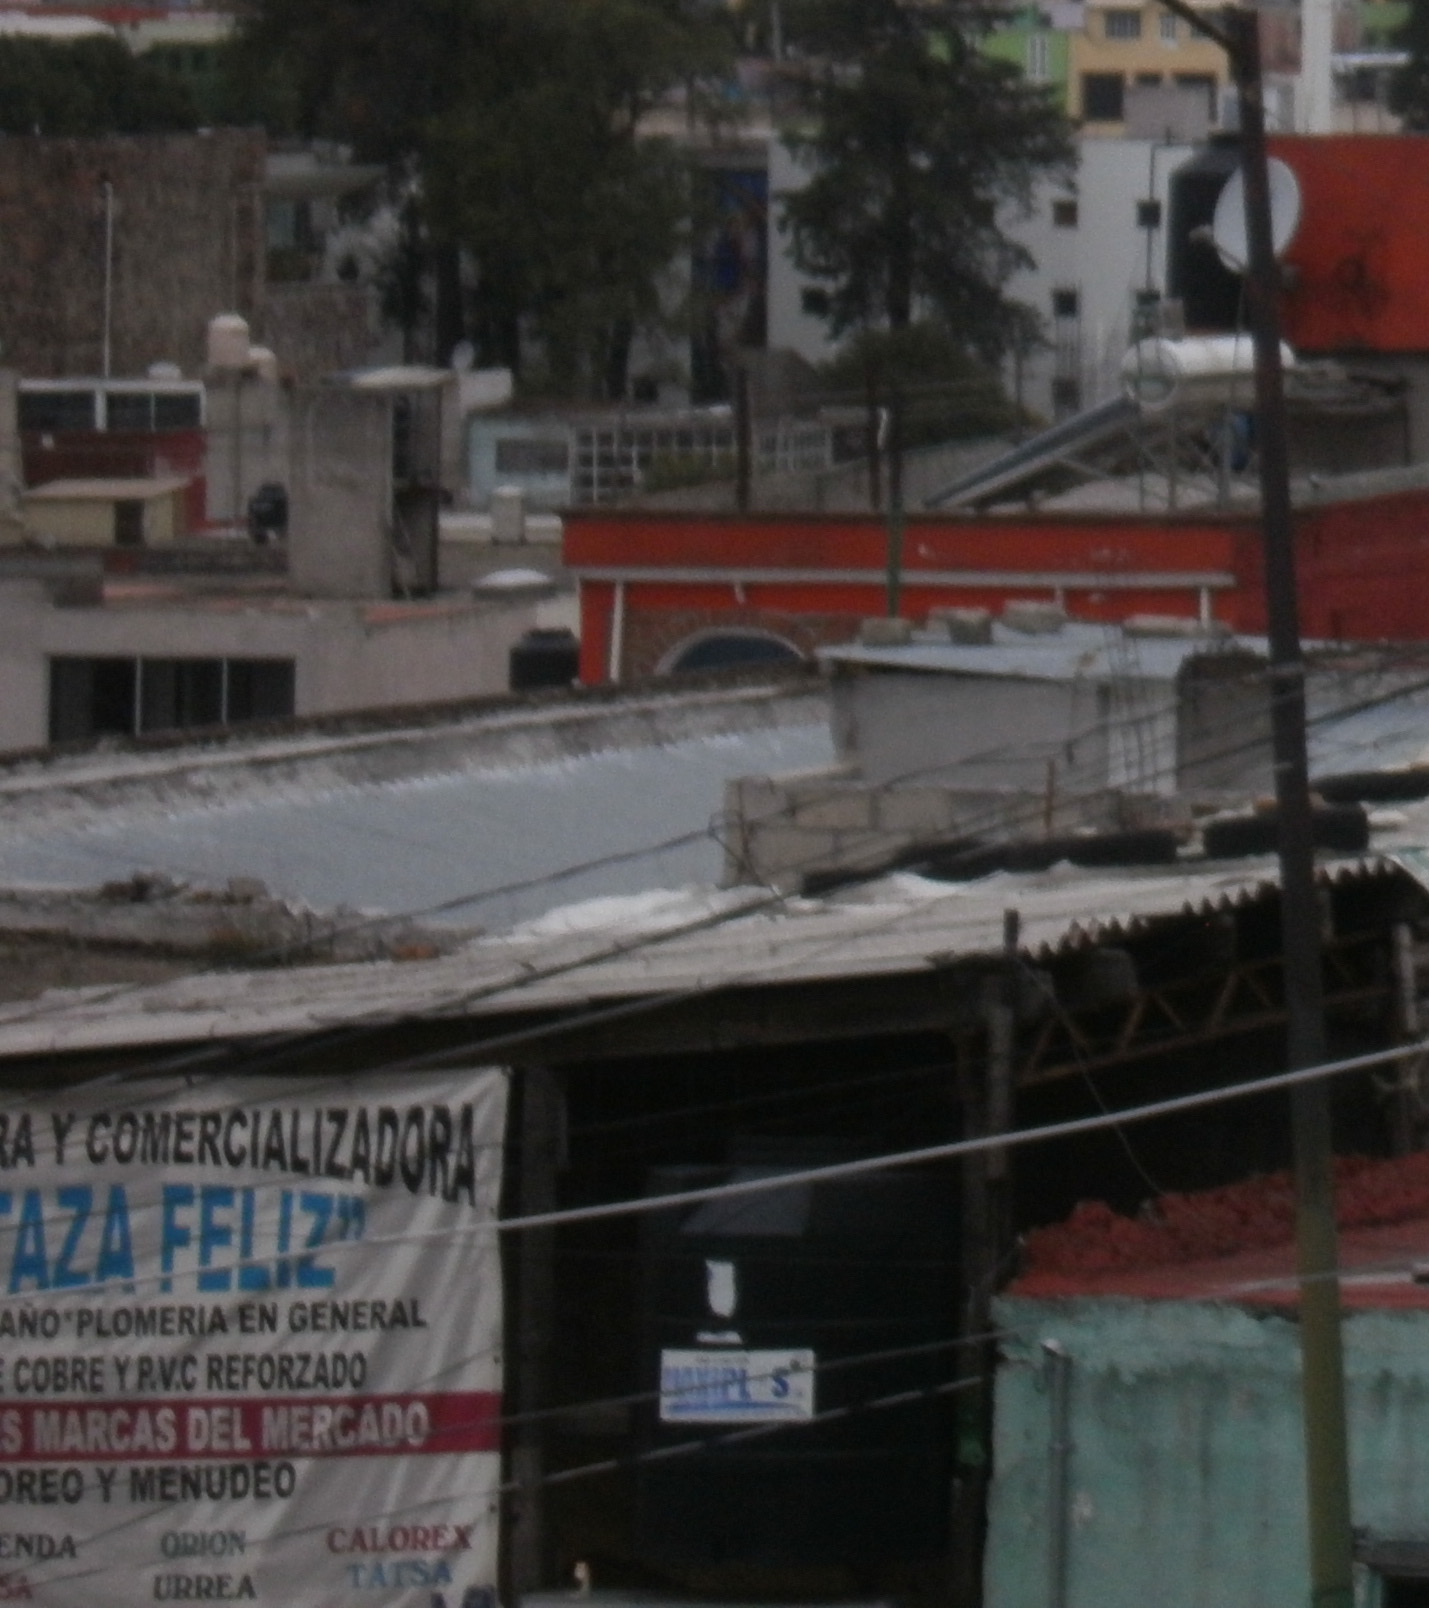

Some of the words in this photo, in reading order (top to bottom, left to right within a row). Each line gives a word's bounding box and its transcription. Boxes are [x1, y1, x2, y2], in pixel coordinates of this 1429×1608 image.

[52, 1111, 75, 1165] Y
[86, 1102, 475, 1208] COMERCIALIZADORA
[238, 1301, 278, 1335] EN
[288, 1297, 428, 1333] GENERAL
[13, 1355, 105, 1394] COBRE
[113, 1354, 131, 1391] Y
[207, 1351, 367, 1391] REFORZADO
[33, 1406, 177, 1454] MARCAS
[187, 1405, 252, 1453] DEL
[261, 1400, 430, 1451] MERCADO
[96, 1465, 117, 1504] Y
[130, 1460, 296, 1505] MENUDEO
[326, 1523, 474, 1555] CALOREX
[153, 1572, 258, 1601] URREA
